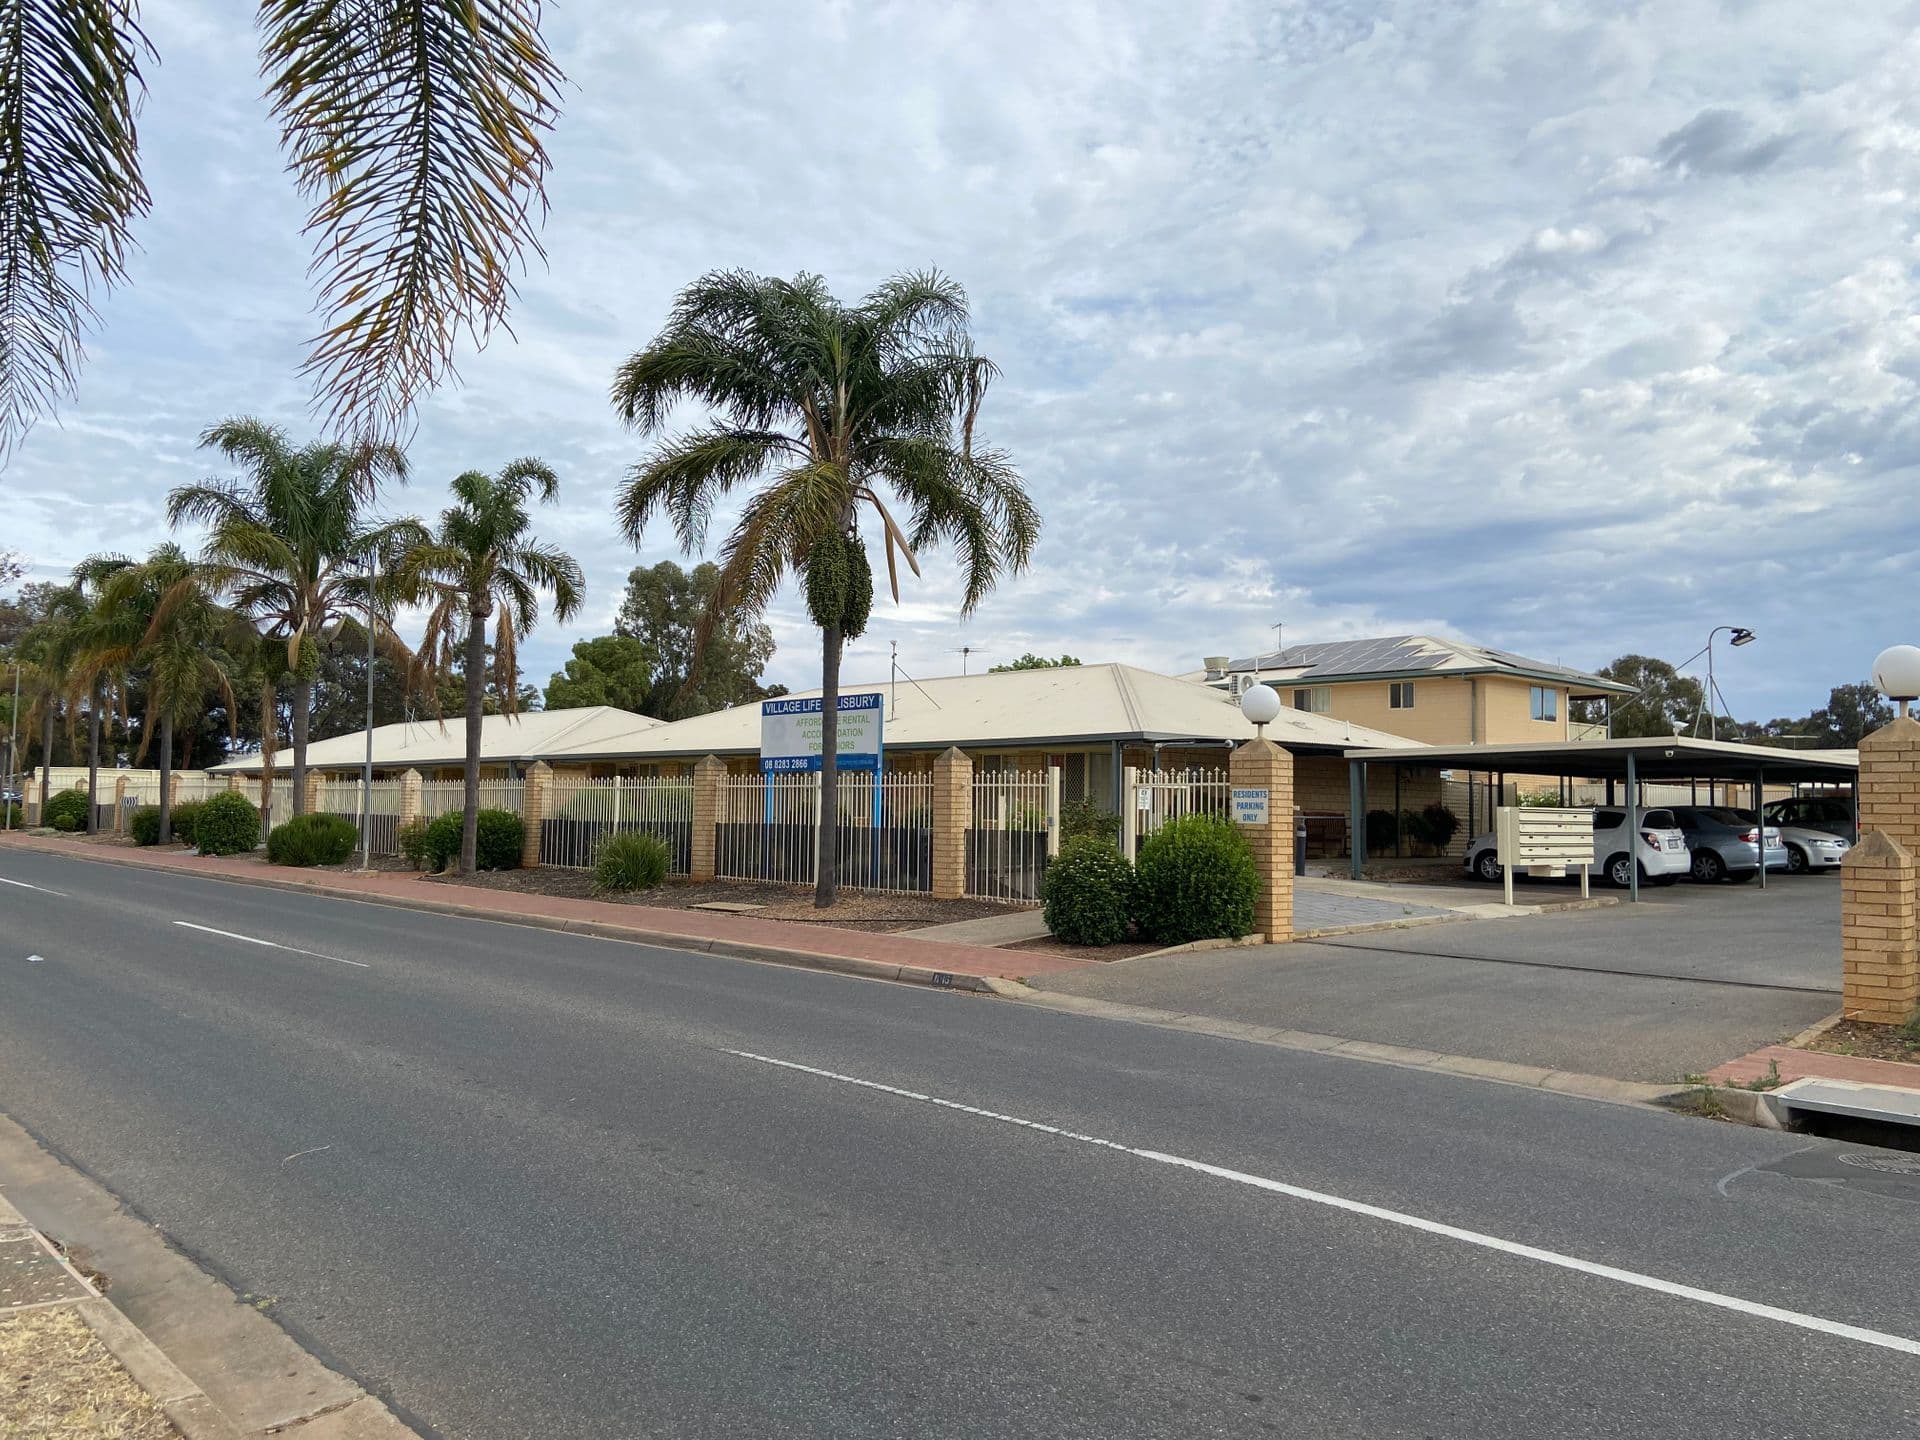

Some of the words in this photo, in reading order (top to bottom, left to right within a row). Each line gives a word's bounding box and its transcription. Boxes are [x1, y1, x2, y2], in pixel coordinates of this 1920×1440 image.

[766, 702, 800, 713] VILLAGE
[802, 699, 821, 711] LIFE
[837, 696, 874, 708] LISBURY
[796, 715, 841, 727] AFFORDE
[842, 715, 870, 725] RENTAL
[802, 728, 863, 739] ACCODATION
[765, 760, 772, 769] 08
[774, 760, 790, 769] 8283
[791, 758, 808, 769] 2866
[1233, 790, 1268, 799] RESIDENTS
[1236, 802, 1265, 810] PARKING
[1242, 813, 1258, 822] ONLY
